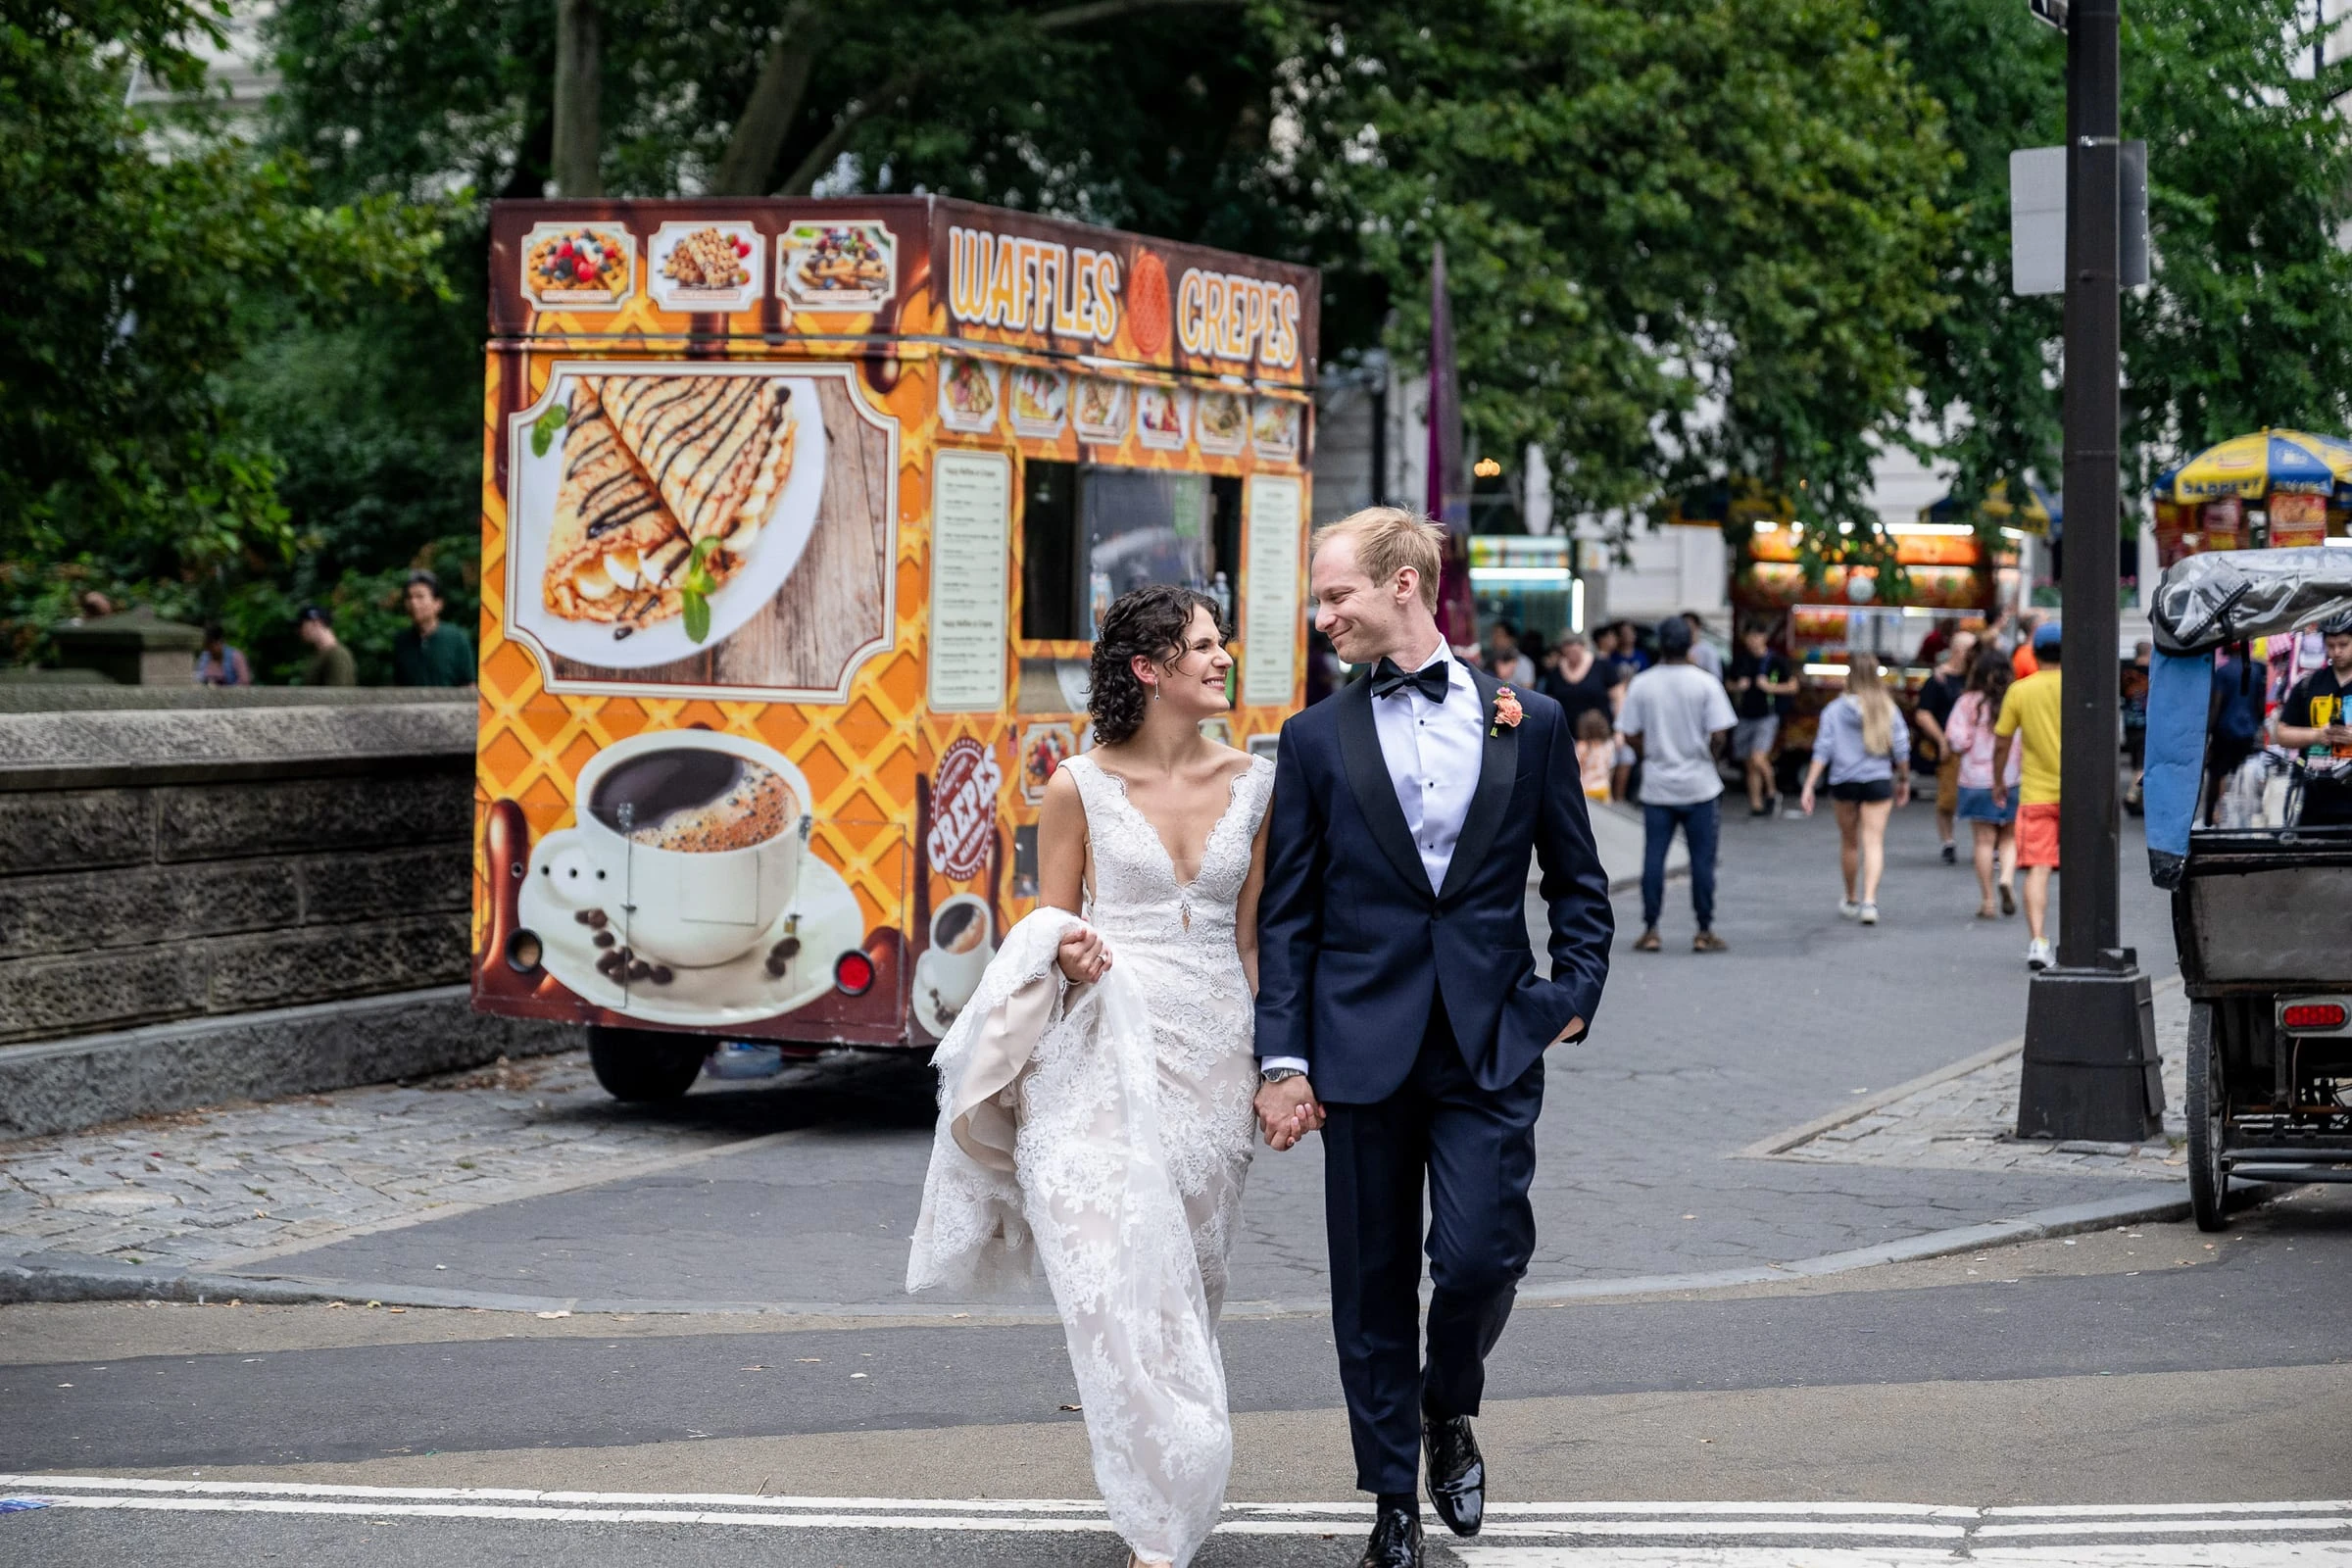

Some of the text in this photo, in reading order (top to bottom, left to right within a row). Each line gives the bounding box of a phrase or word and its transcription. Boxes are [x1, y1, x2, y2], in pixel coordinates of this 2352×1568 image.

[949, 226, 1300, 368] WAFFLES CREPES
[927, 742, 1003, 873] CREPES
